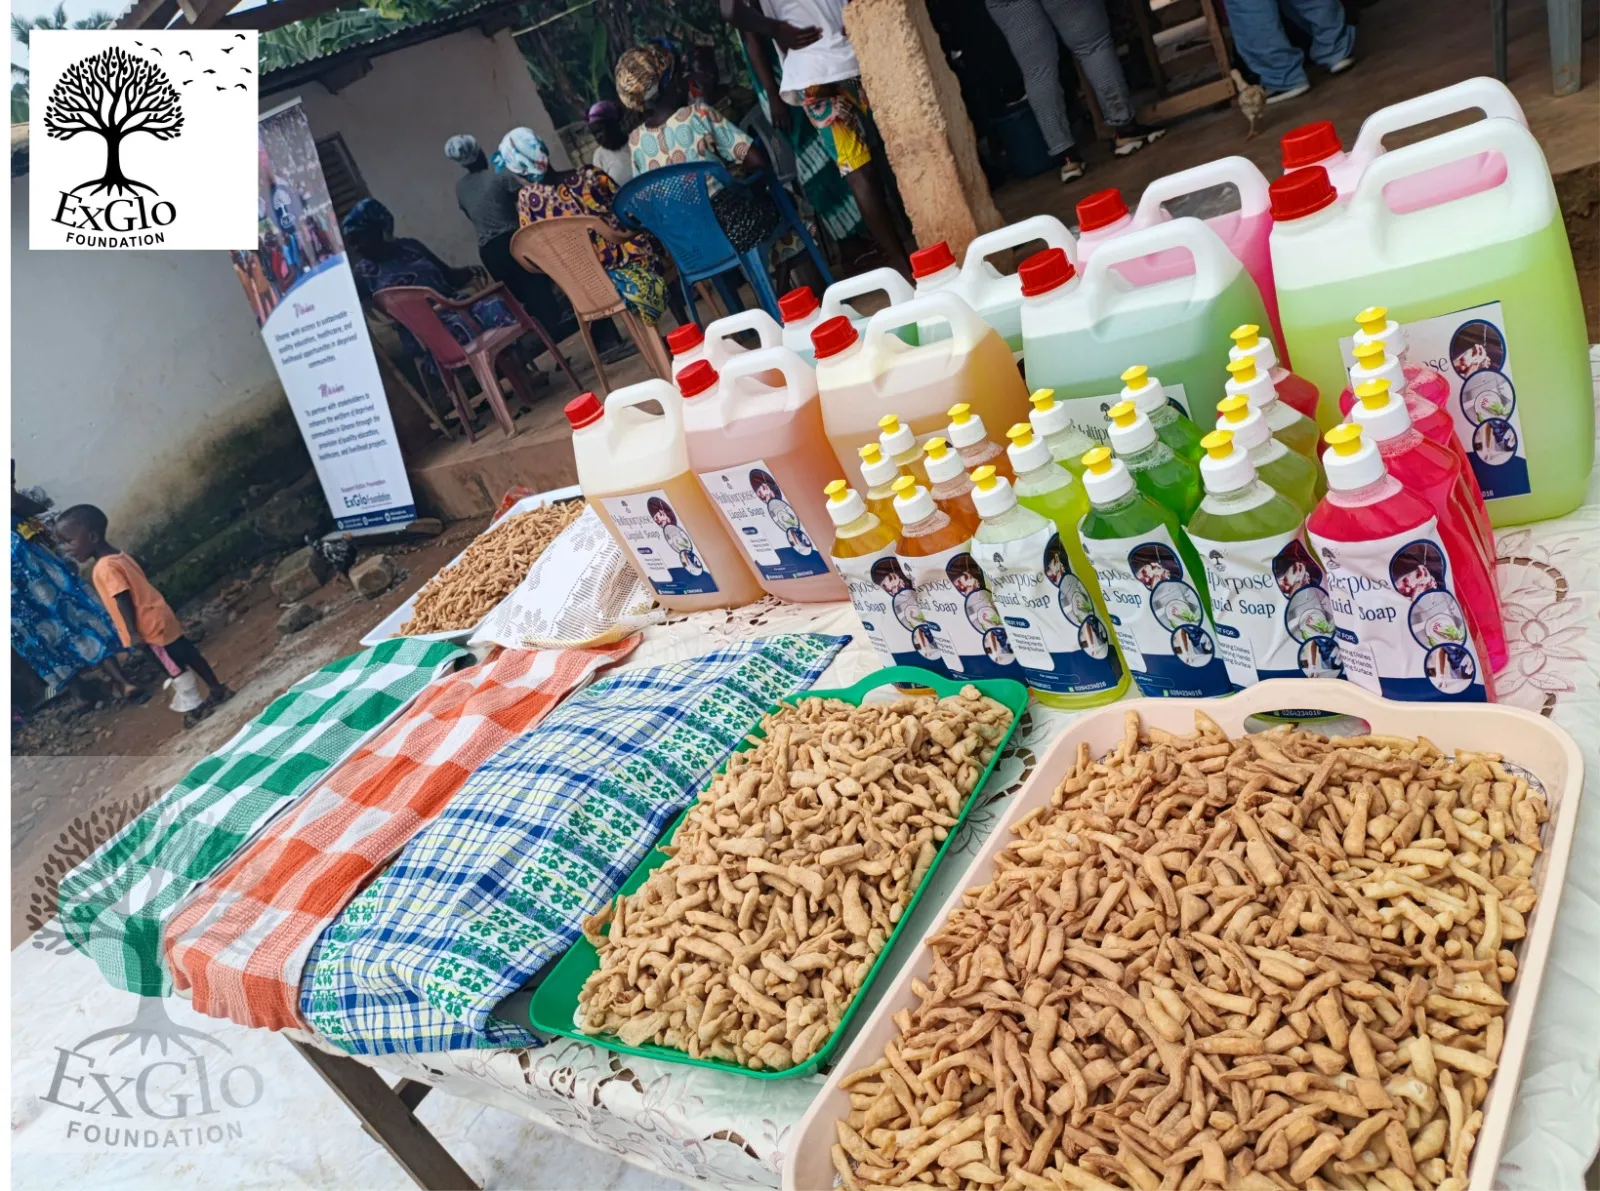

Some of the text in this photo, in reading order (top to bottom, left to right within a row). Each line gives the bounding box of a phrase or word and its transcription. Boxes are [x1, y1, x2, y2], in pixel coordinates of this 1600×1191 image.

[863, 600, 886, 614] Soap
[931, 599, 957, 614] Soap
[1021, 594, 1050, 609] Soap
[1112, 590, 1141, 608] Soap
[1212, 597, 1275, 618] uid Soap
[1331, 598, 1396, 622] uid Soap
